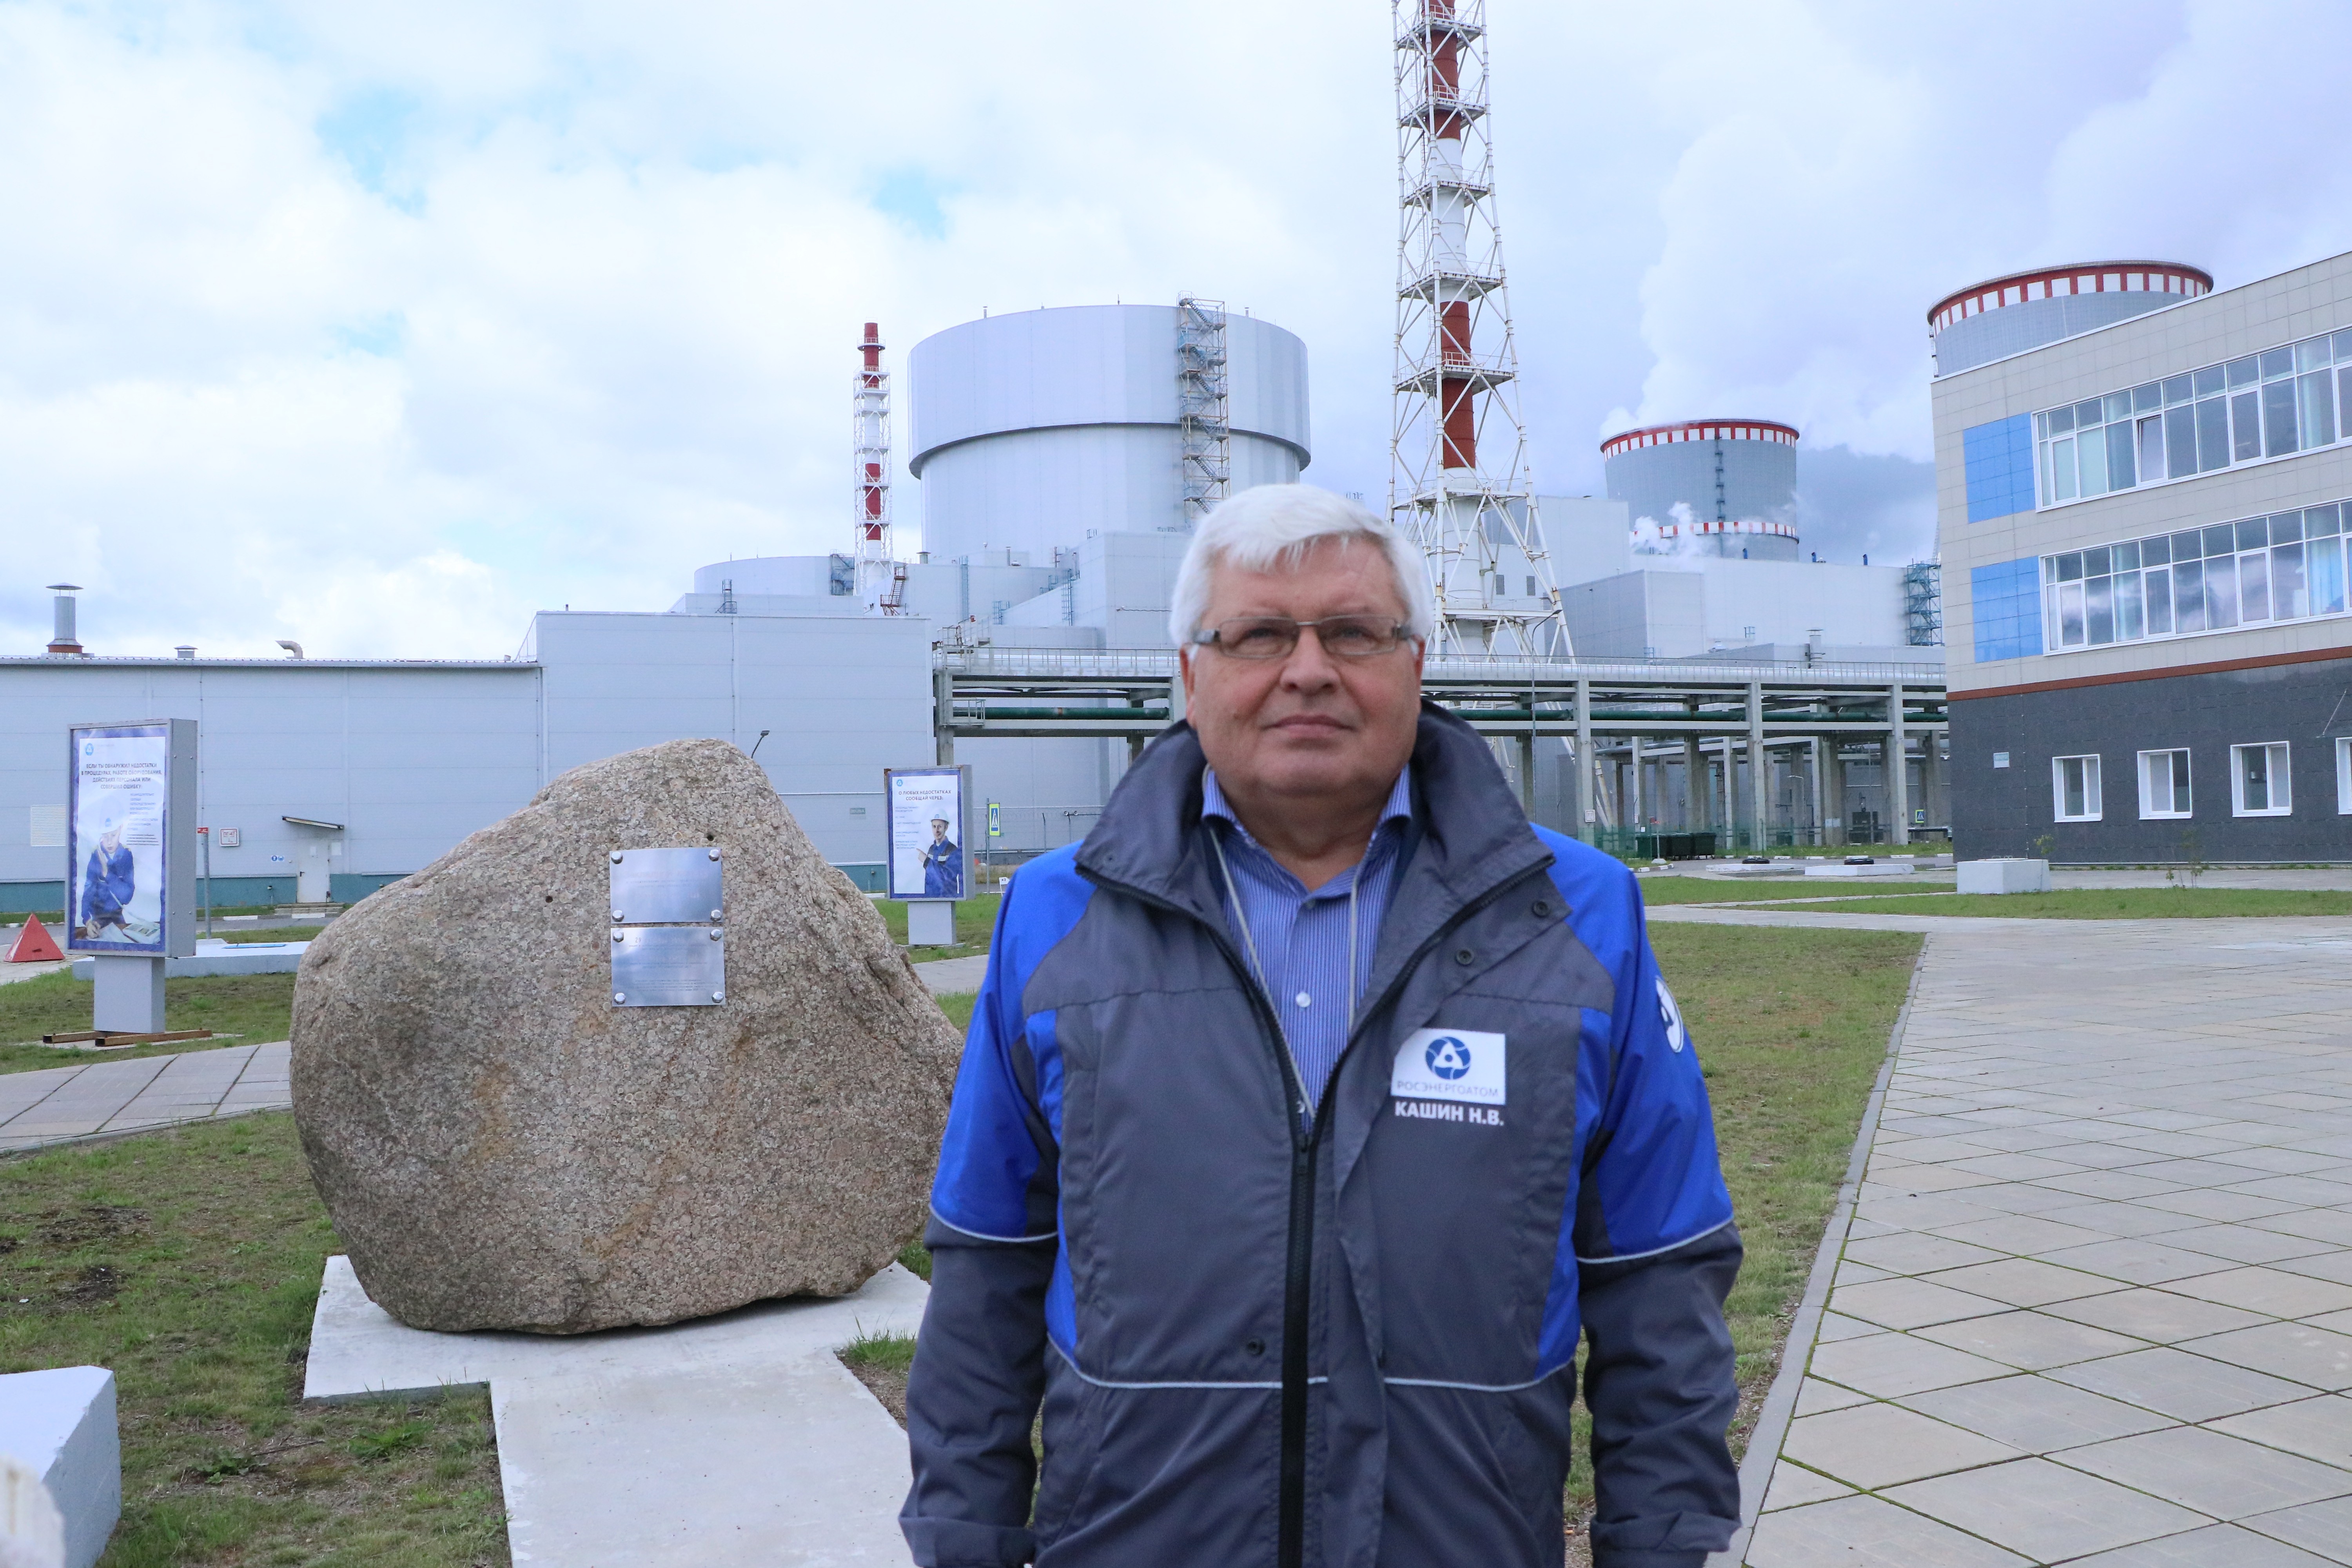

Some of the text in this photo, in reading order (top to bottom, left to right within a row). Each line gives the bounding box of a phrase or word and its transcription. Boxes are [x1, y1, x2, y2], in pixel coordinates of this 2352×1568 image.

[1397, 1080, 1499, 1097] РОСЭНЕРГОАТОМ
[1394, 1101, 1504, 1126] КАШИН Н.В.
